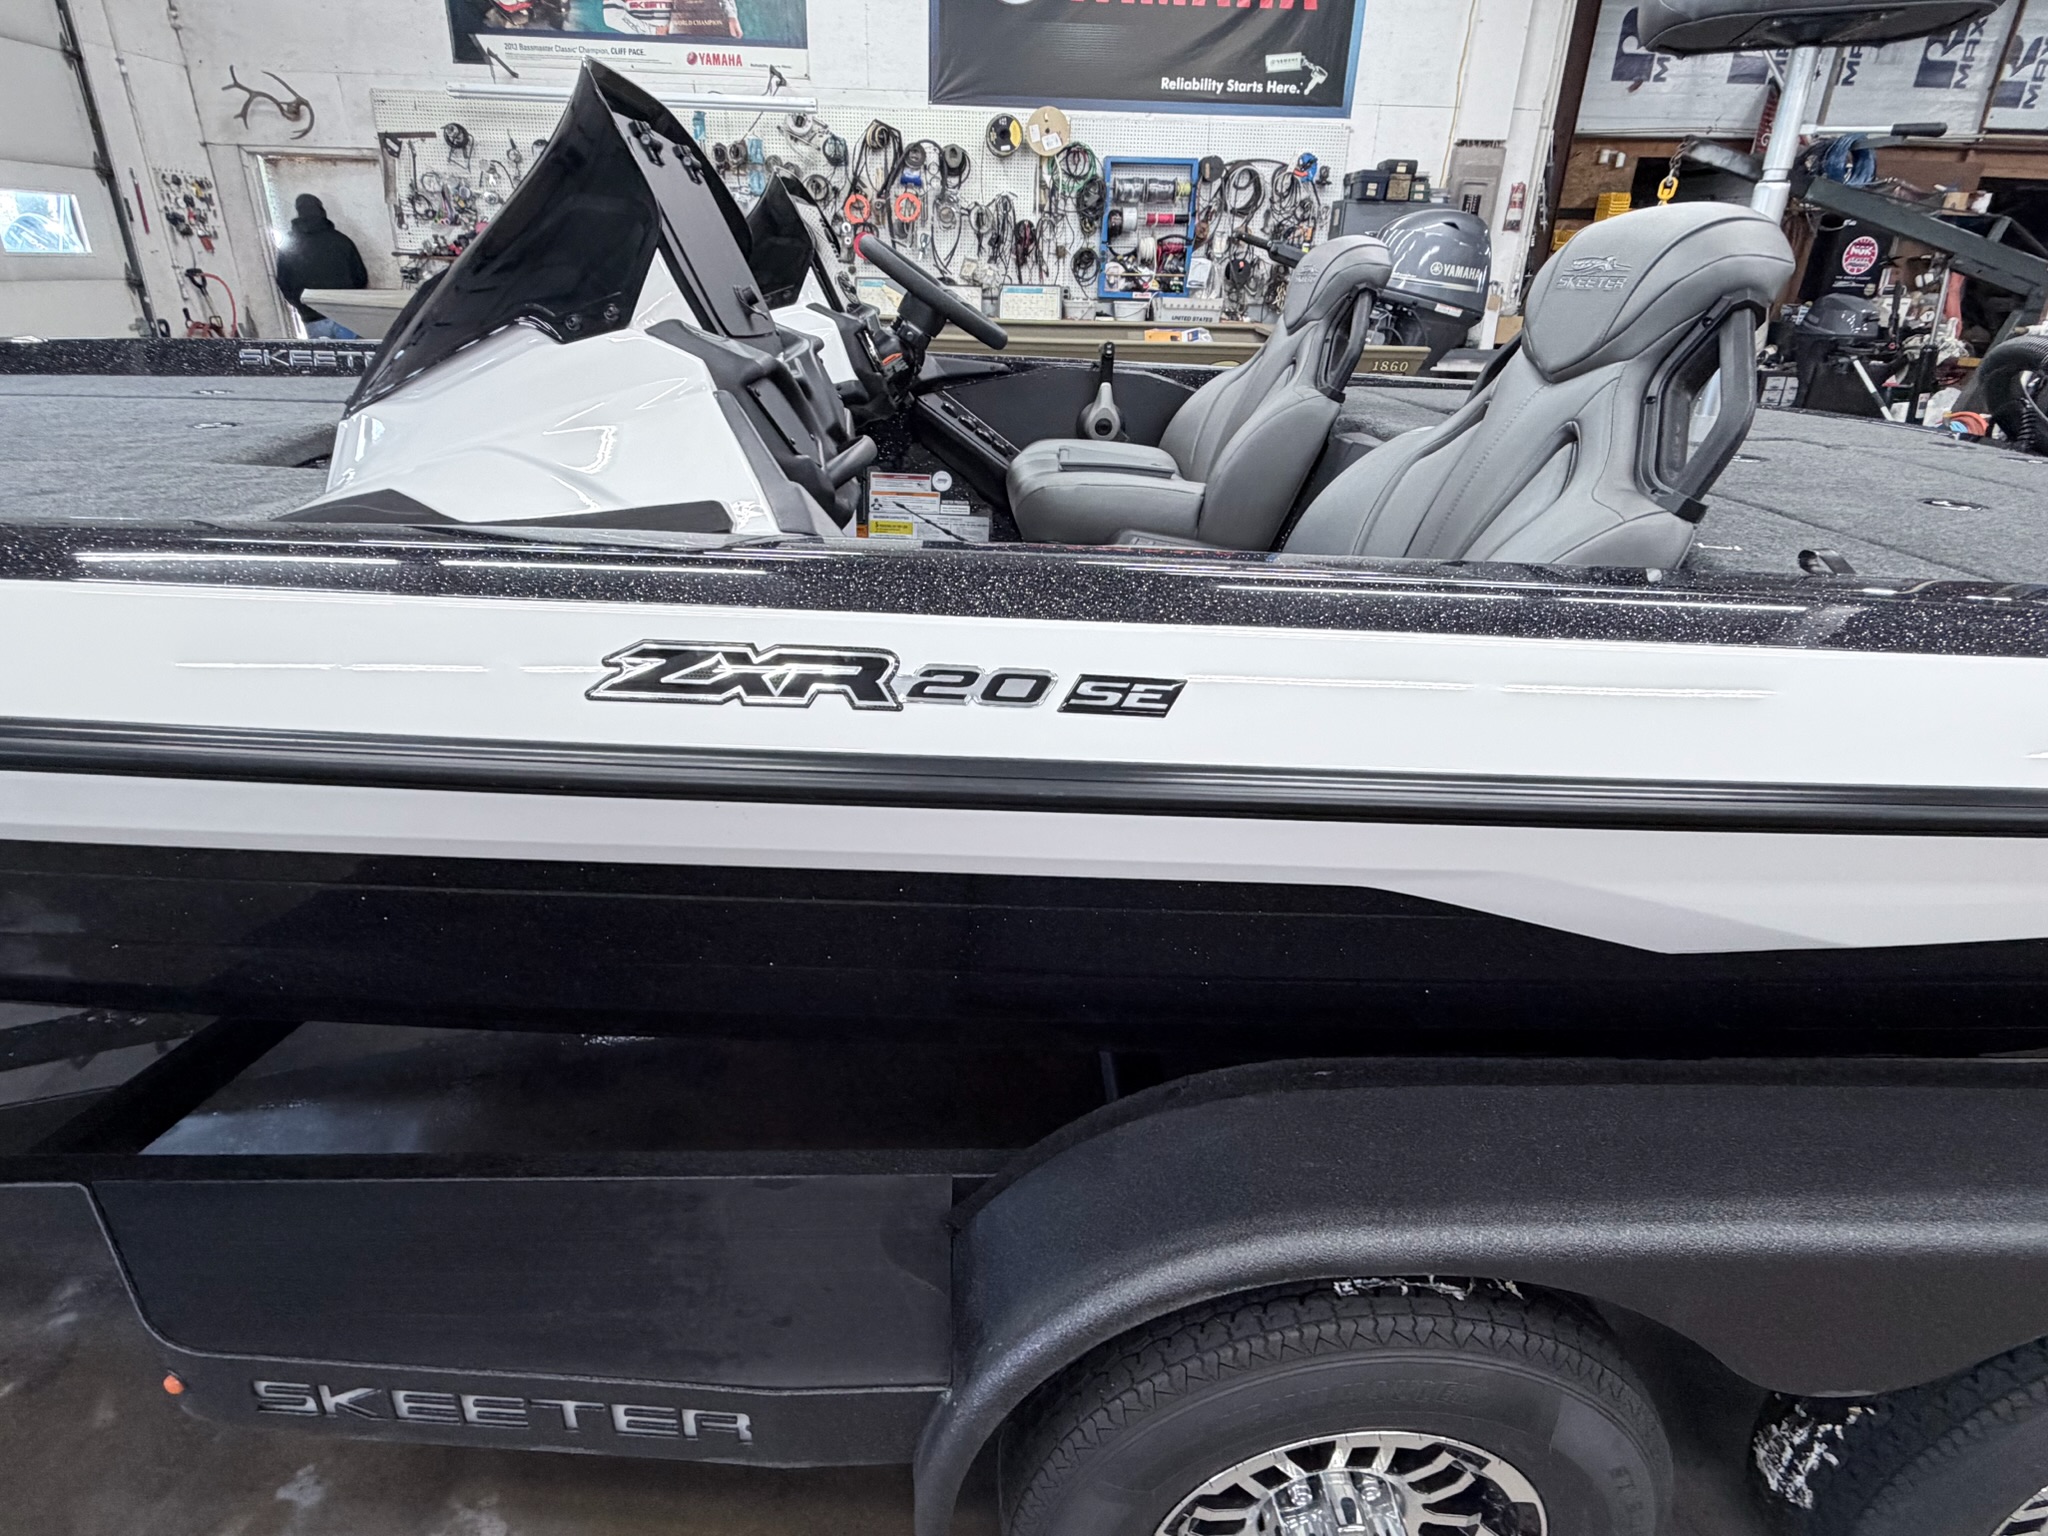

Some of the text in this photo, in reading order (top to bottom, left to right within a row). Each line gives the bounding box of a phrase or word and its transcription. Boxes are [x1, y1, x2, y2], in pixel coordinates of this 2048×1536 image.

[519, 43, 553, 52] Bassmaster
[610, 47, 626, 56] CLIFF
[698, 53, 743, 67] YAMAHA
[1161, 77, 1301, 94] Reliability Starts Here.
[1443, 263, 1481, 280] YAMAHA
[1556, 275, 1628, 290] SKEETER
[1371, 361, 1409, 372] 1860
[585, 639, 1174, 712] ZXR 20 SE
[253, 1380, 753, 1445] SKEETER
